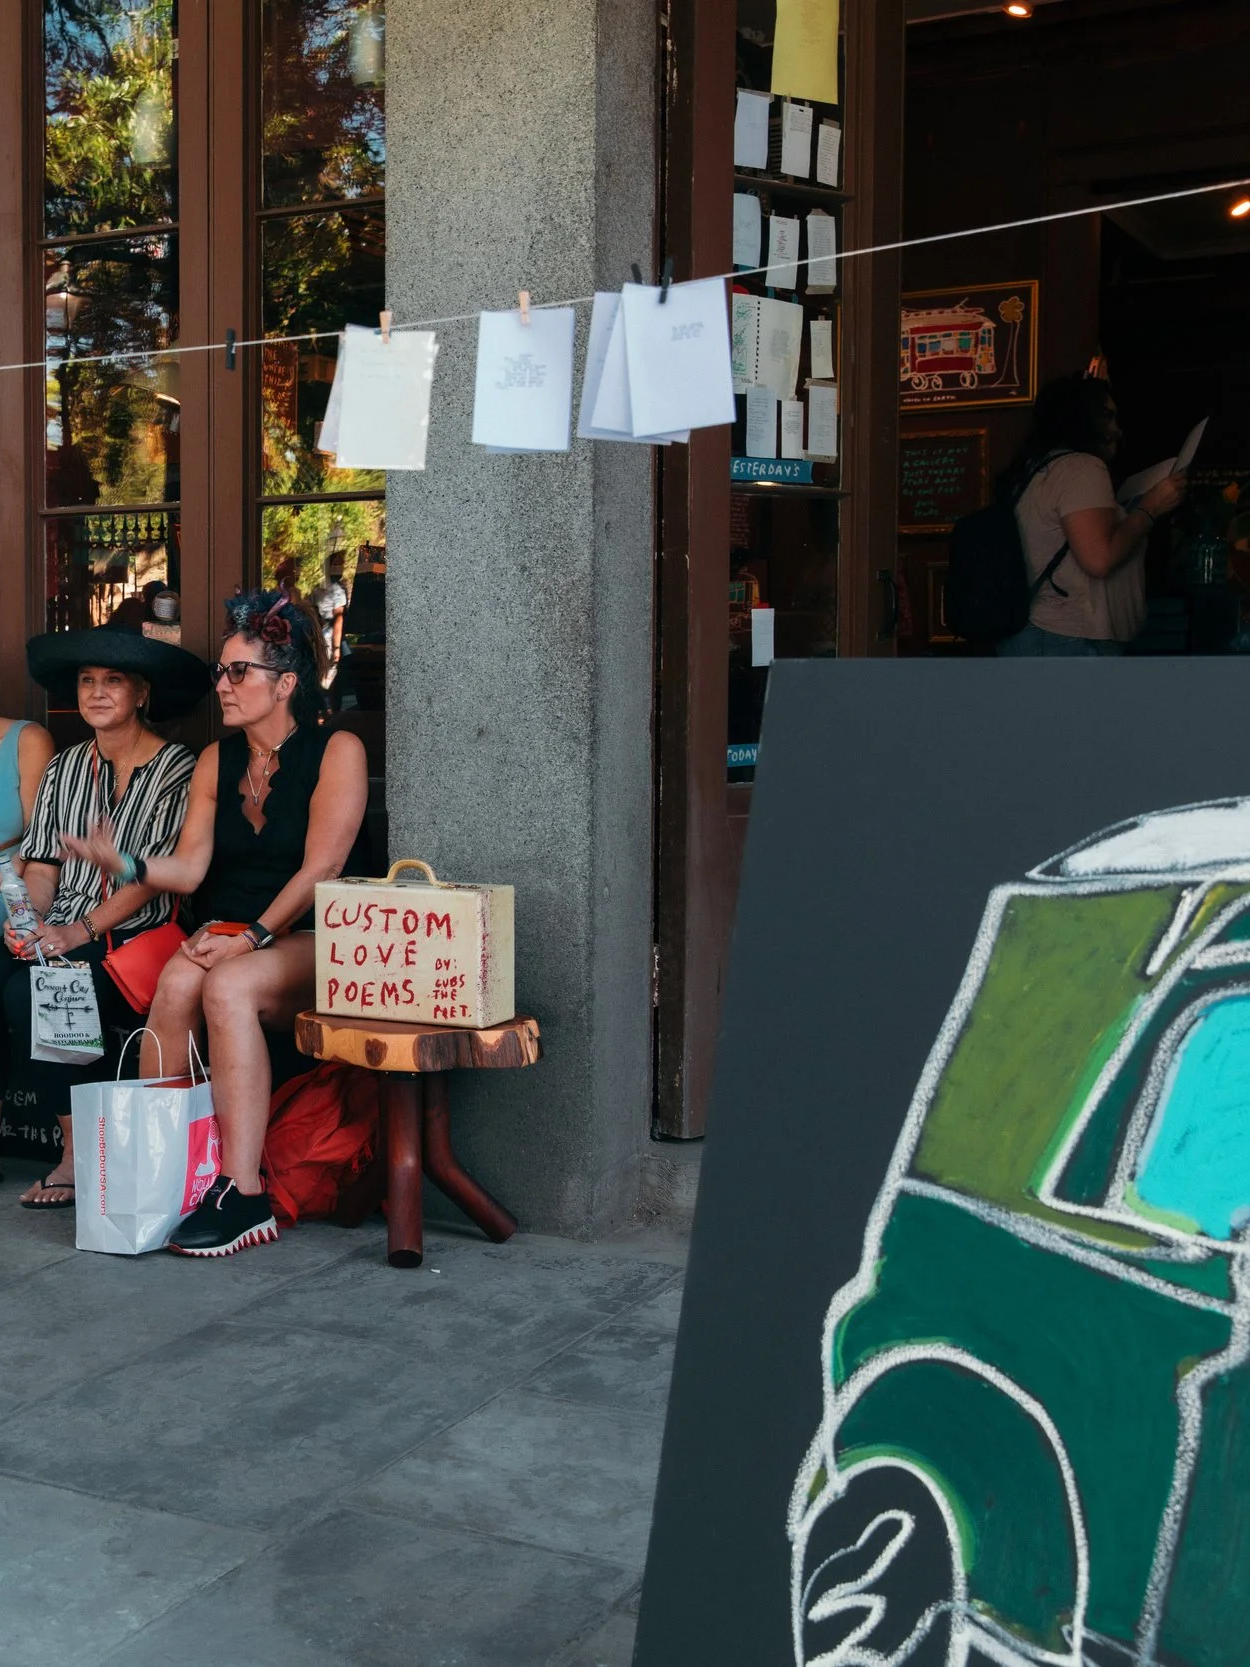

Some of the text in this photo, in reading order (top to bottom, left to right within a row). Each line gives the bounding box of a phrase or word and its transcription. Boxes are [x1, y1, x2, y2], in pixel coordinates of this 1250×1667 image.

[732, 460, 800, 477] ESTERDAY'S
[324, 900, 452, 940] CUSTOM
[330, 940, 417, 967] LOVE
[432, 989, 457, 1000] THE
[98, 1116, 107, 1216] ShoeBeDoUSA.com
